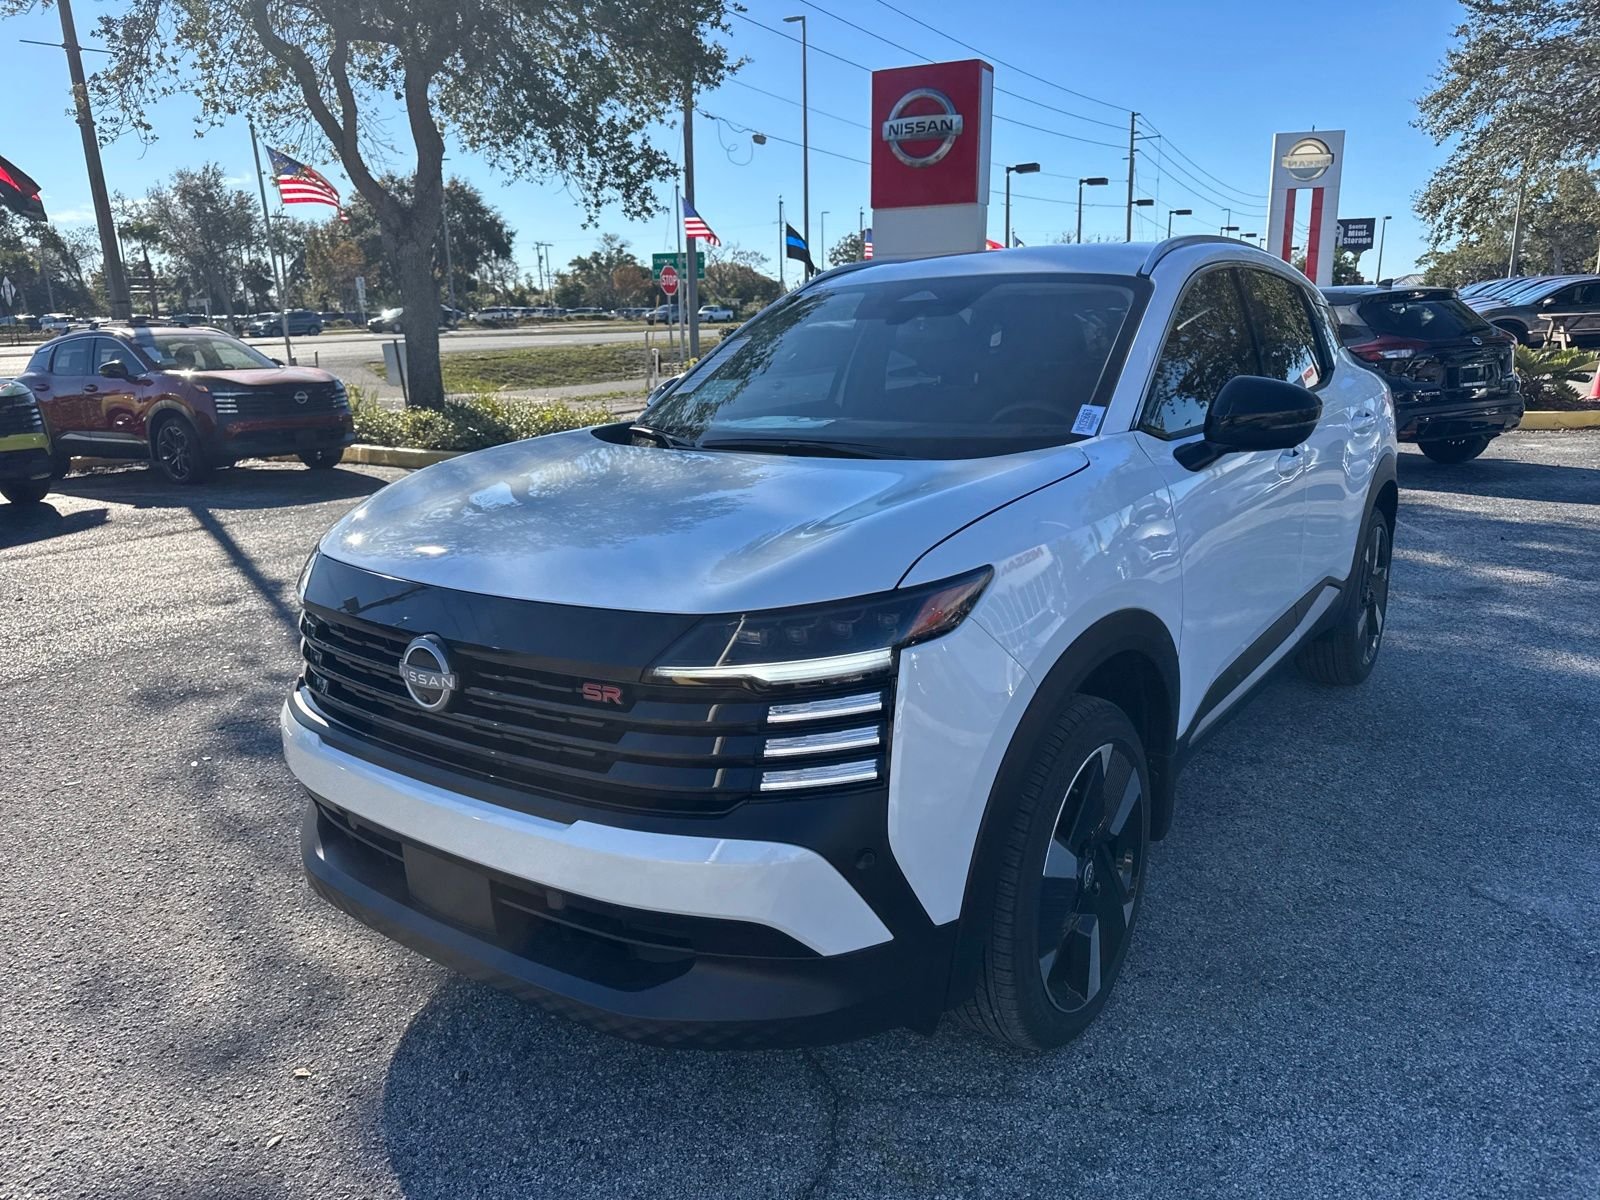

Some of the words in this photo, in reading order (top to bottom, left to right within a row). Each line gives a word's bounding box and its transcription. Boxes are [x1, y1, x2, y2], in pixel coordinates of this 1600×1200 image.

[888, 119, 953, 136] NISSAN
[1343, 237, 1372, 245] Storage
[661, 274, 677, 286] STOP
[399, 664, 453, 688] NISSAN
[582, 683, 622, 704] SR
